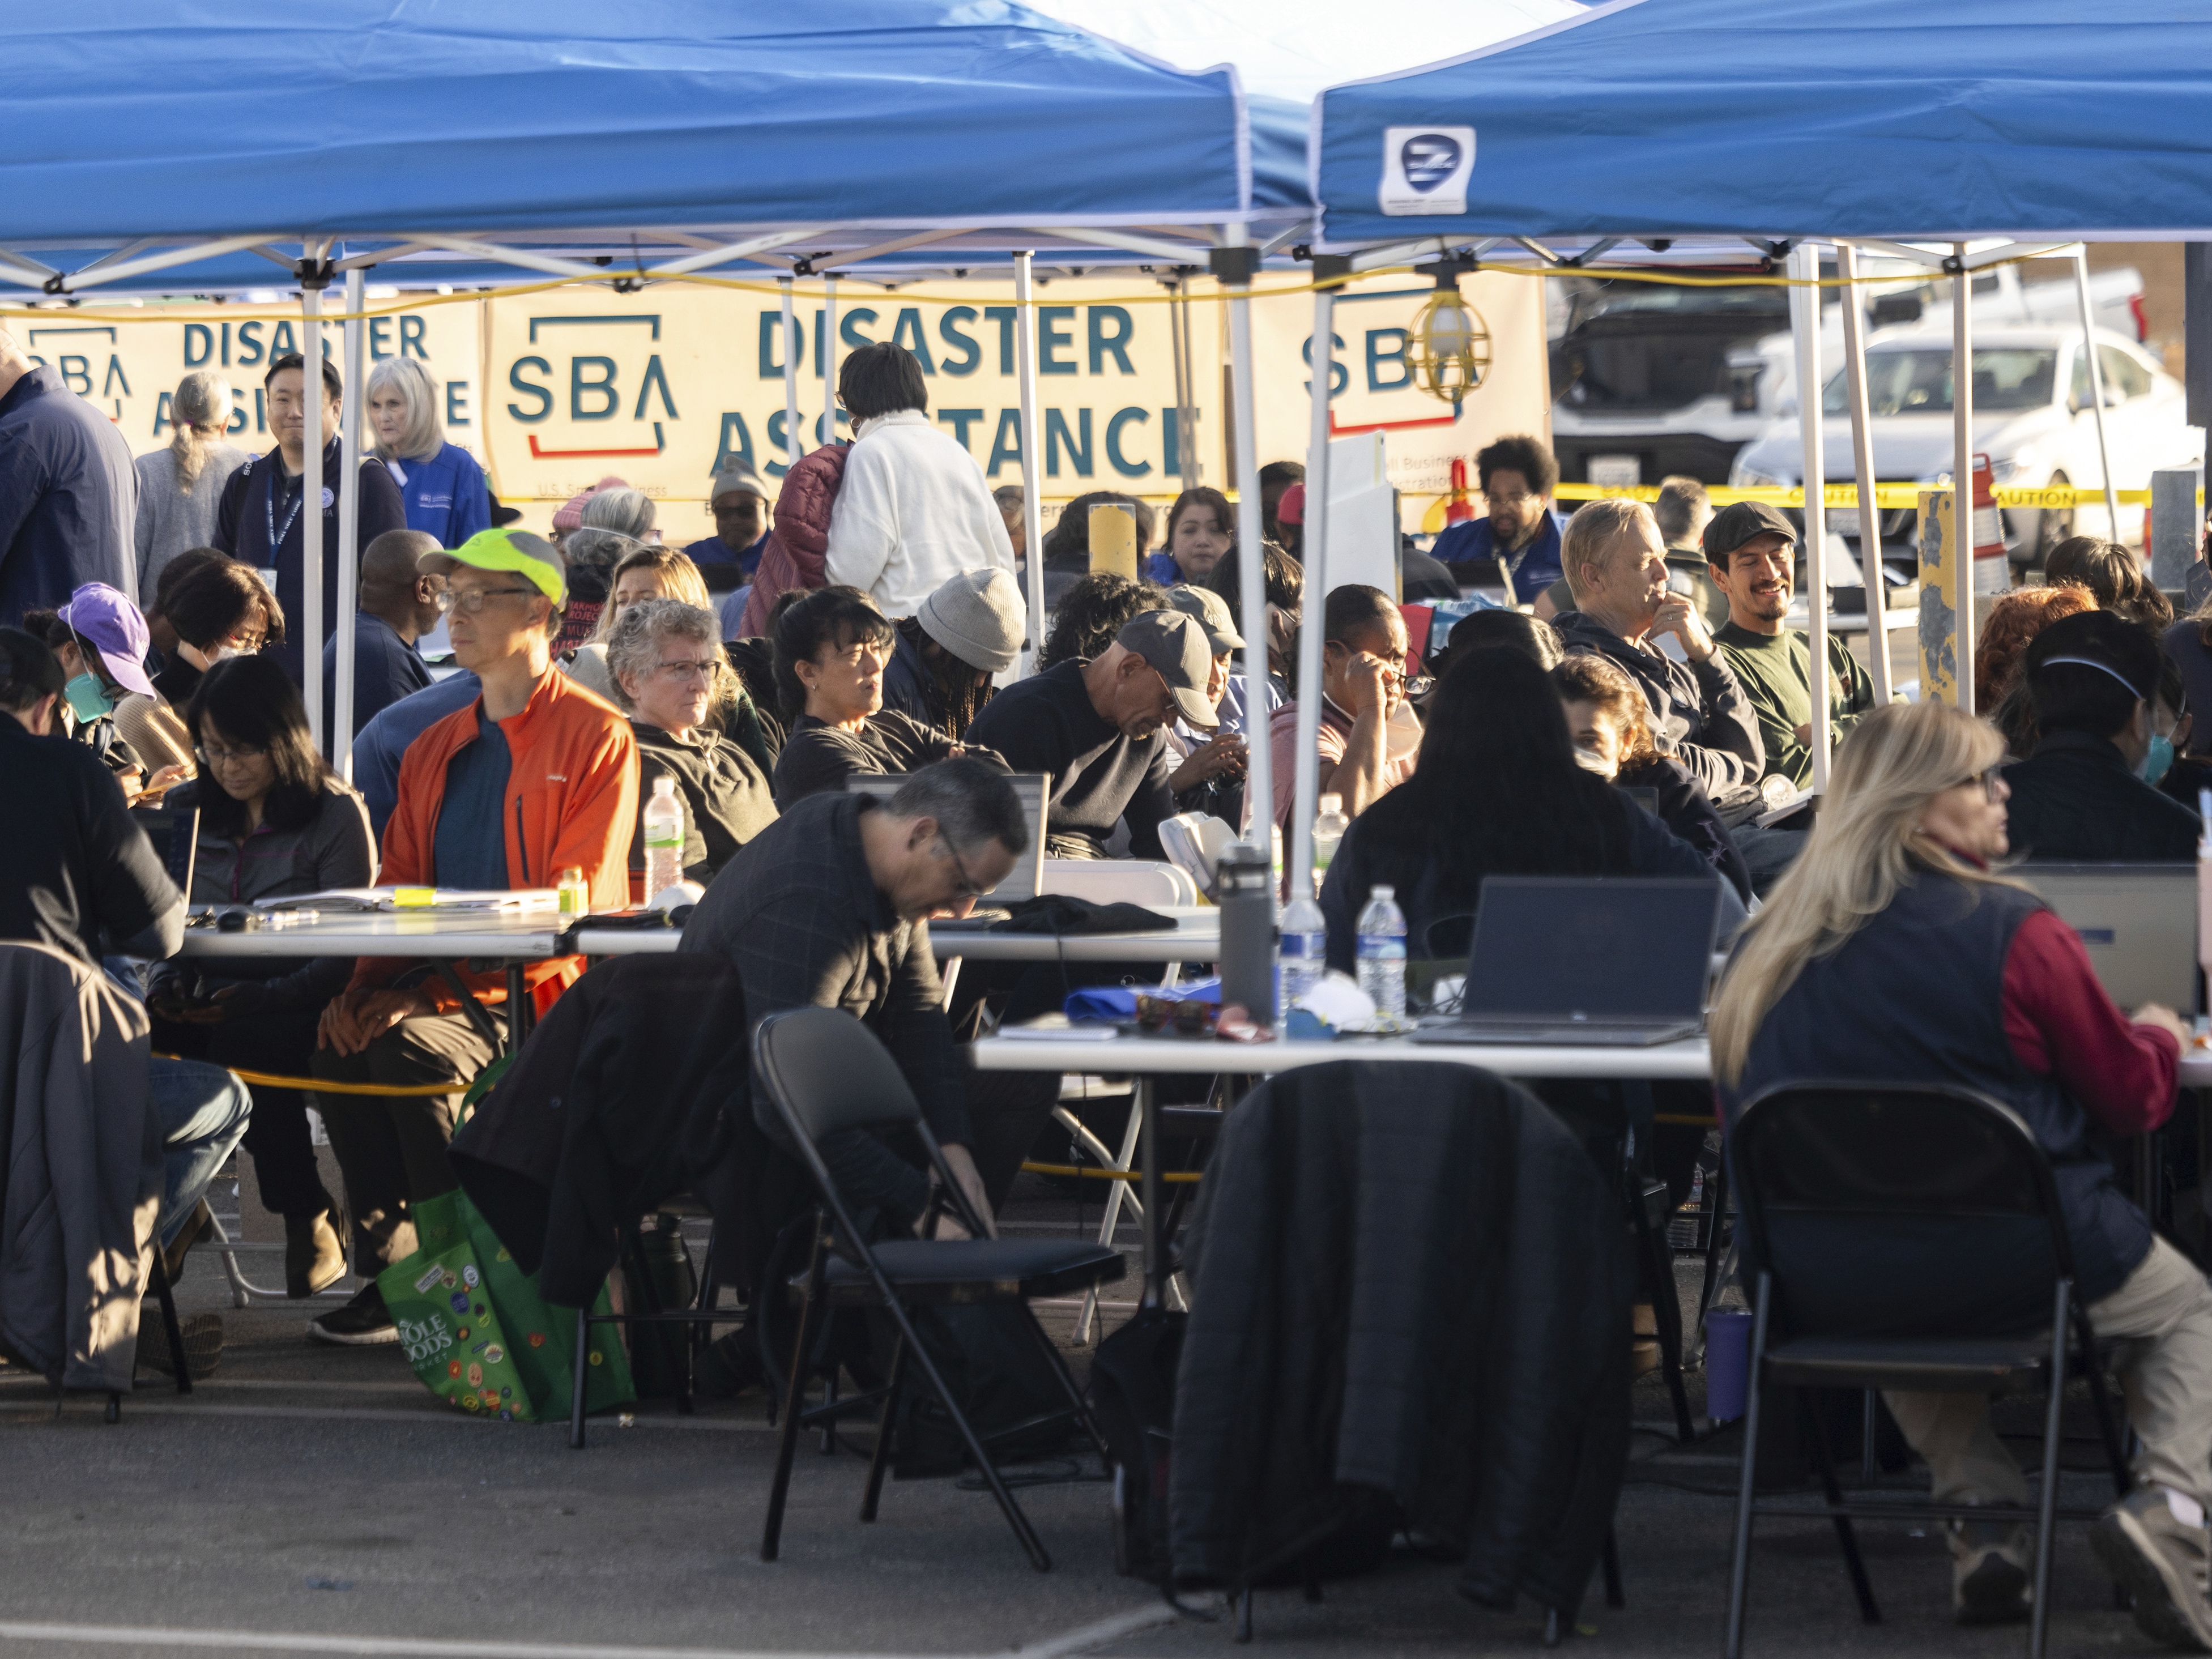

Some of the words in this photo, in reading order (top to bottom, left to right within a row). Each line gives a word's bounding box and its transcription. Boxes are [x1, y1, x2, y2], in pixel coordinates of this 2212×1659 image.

[184, 315, 429, 368] DISAER
[27, 353, 134, 399] BA
[508, 355, 680, 423] SBA
[1997, 491, 2077, 505] AUTION
[1207, 614, 1225, 624] GAP
